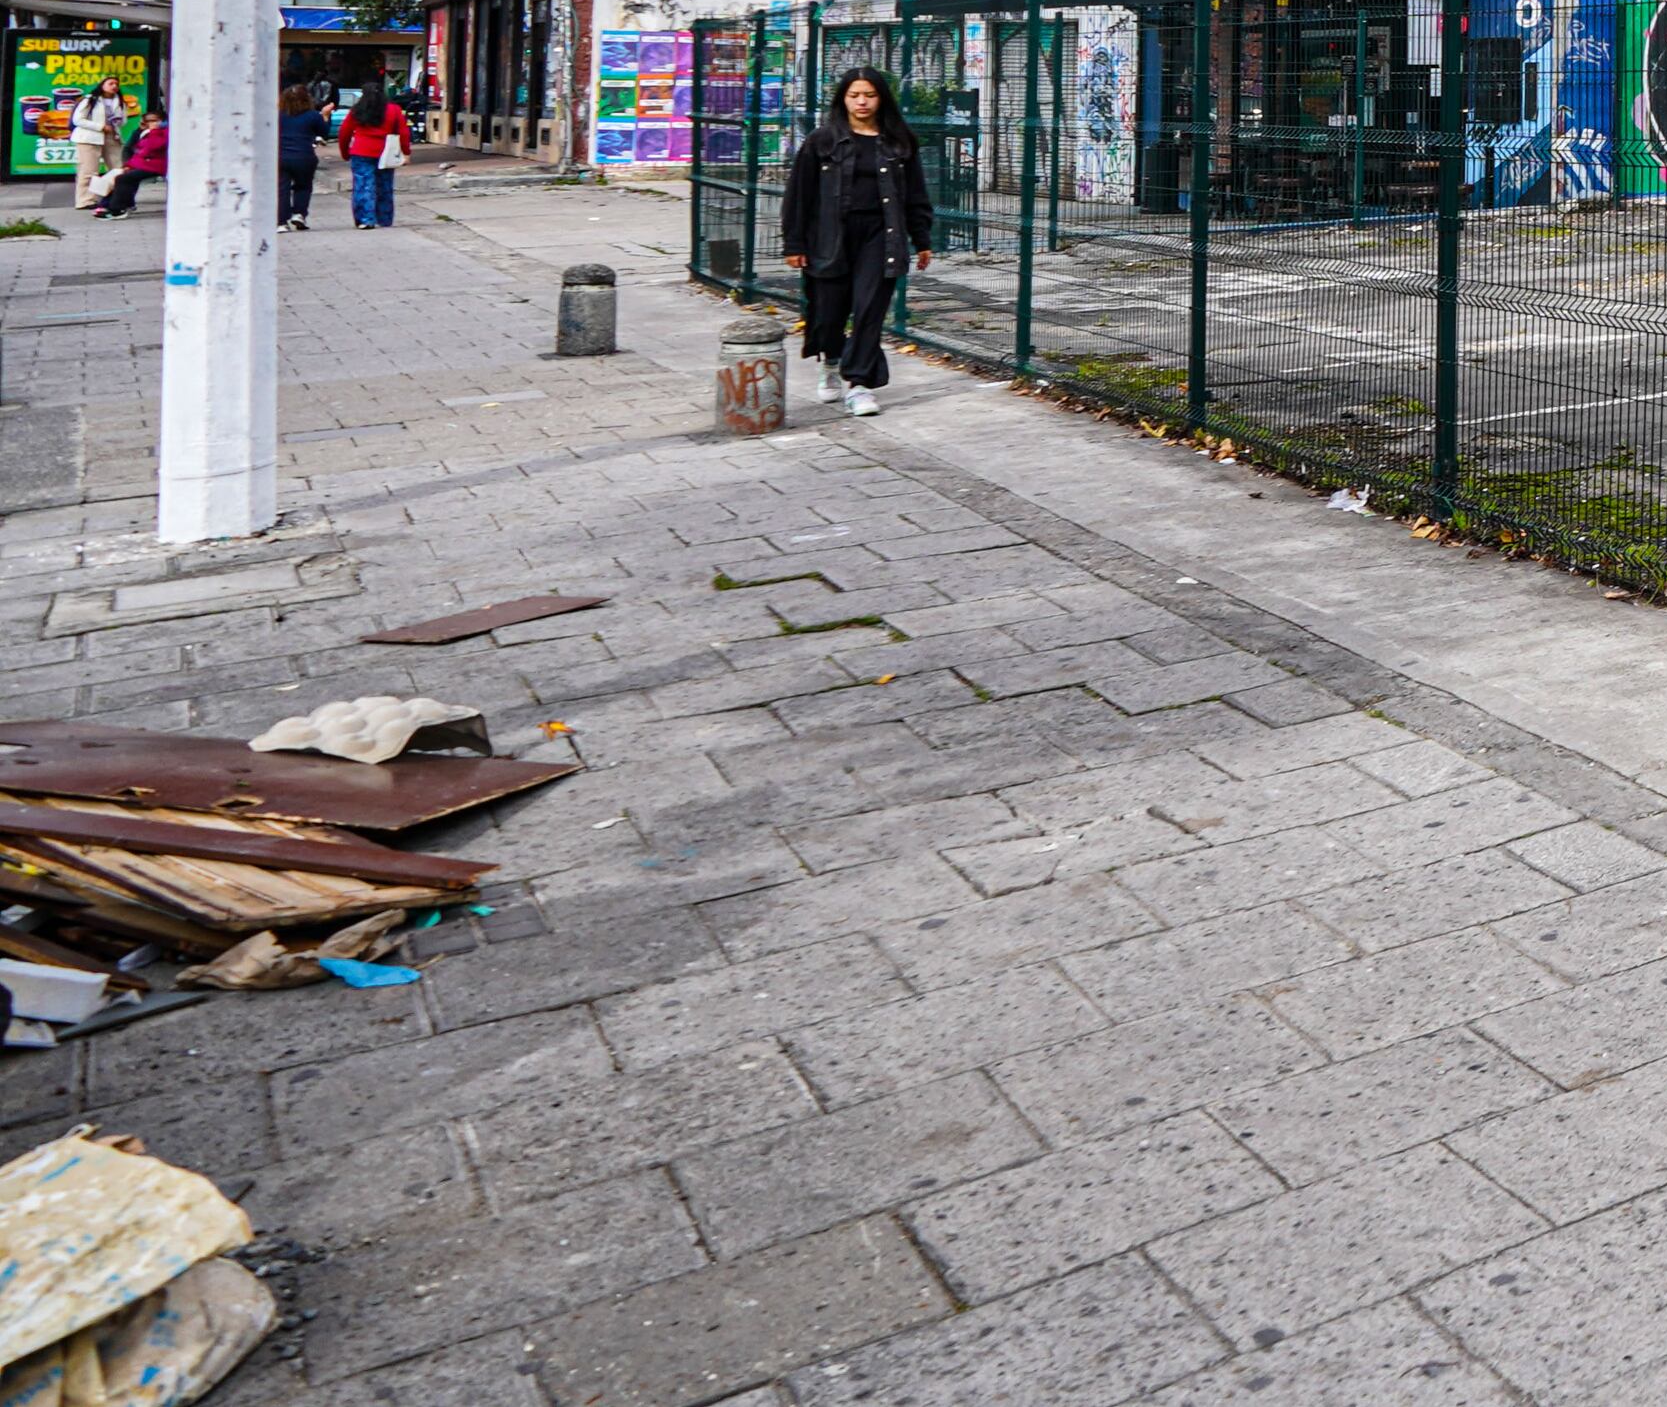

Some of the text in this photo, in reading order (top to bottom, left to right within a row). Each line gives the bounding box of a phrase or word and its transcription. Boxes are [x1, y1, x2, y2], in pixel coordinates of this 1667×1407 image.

[19, 39, 111, 52] SUBWAY
[46, 55, 146, 74] PROMO
[51, 73, 144, 85] APANDA
